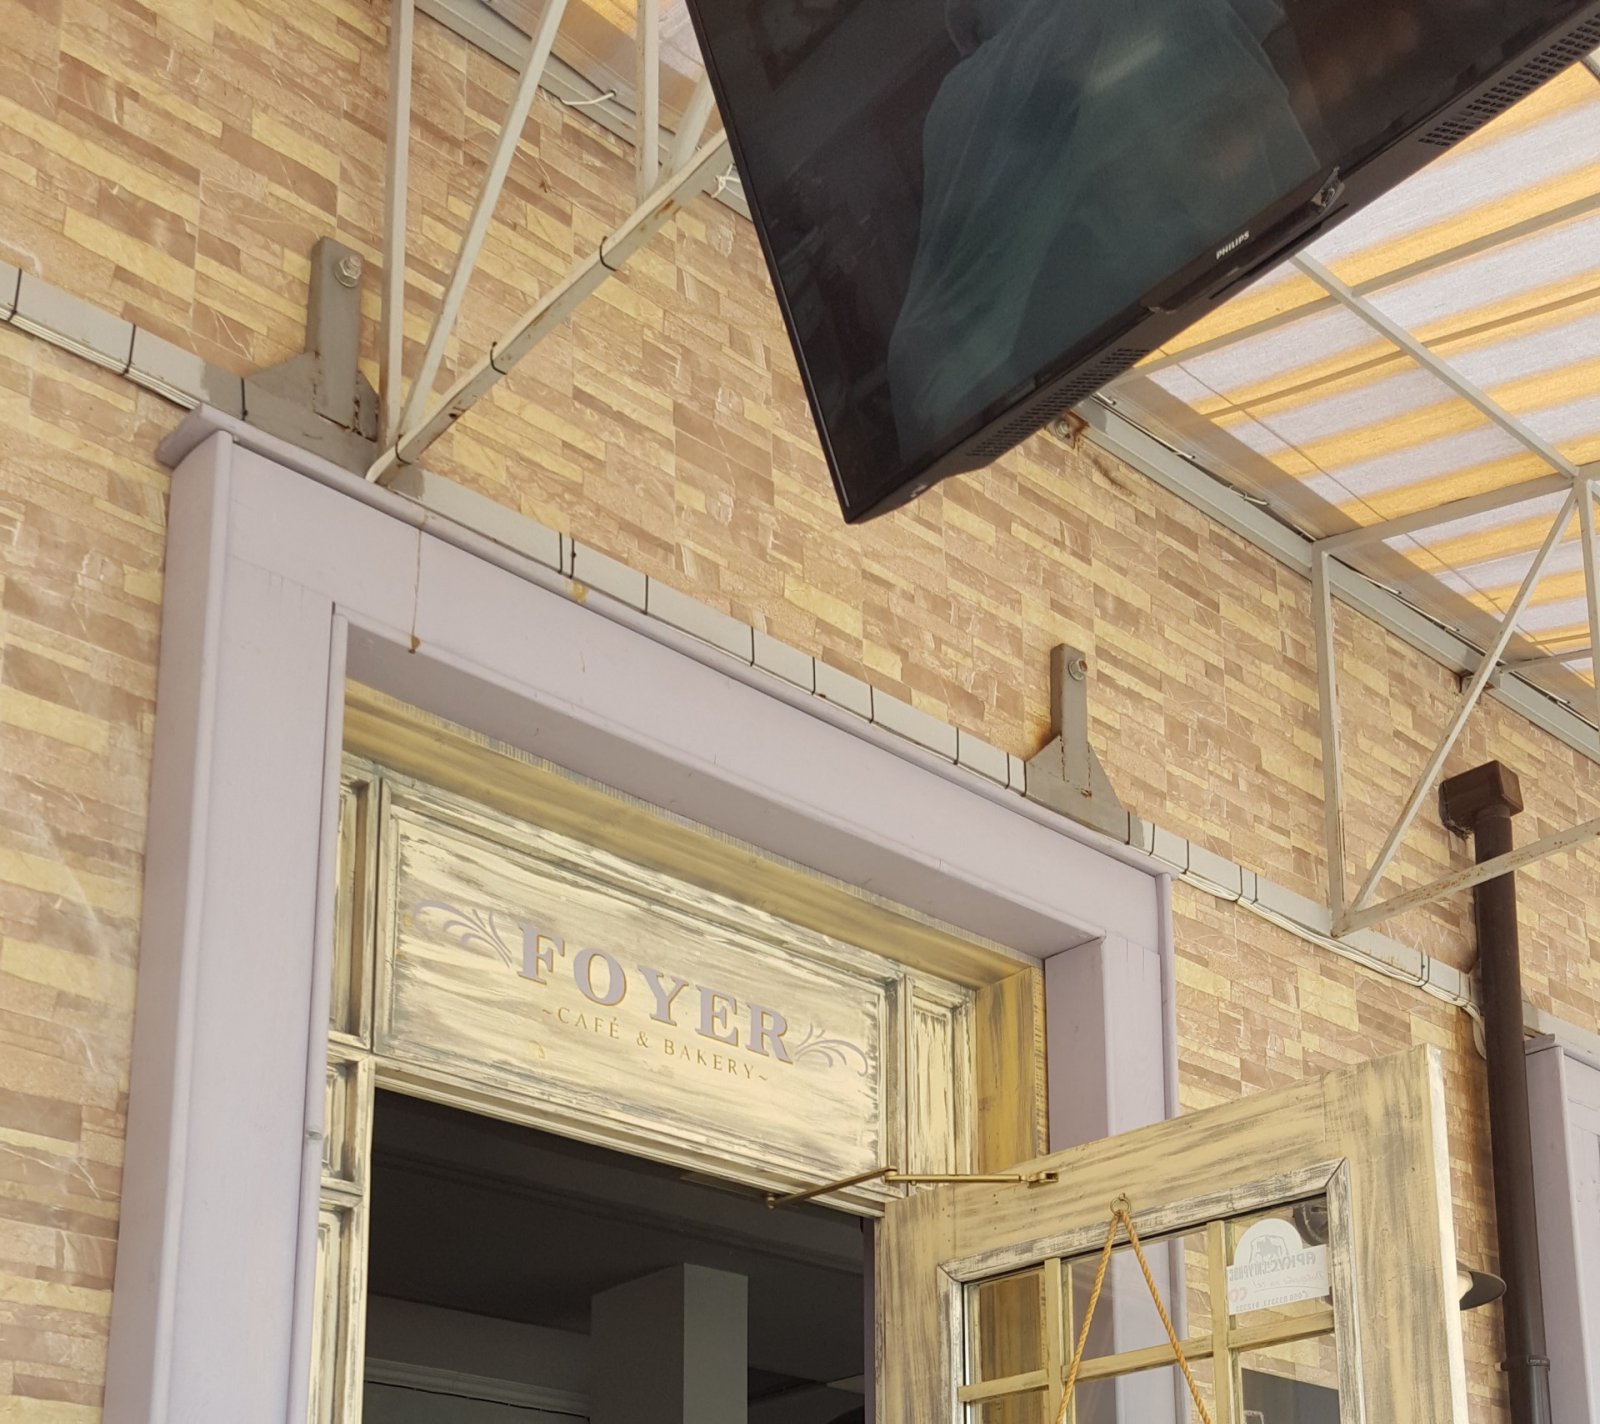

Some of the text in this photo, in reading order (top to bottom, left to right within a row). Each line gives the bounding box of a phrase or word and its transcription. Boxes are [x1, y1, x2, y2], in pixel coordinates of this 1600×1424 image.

[1216, 229, 1250, 260] PHILIPS
[517, 922, 795, 1064] FOYER
[636, 1030, 649, 1049] &
